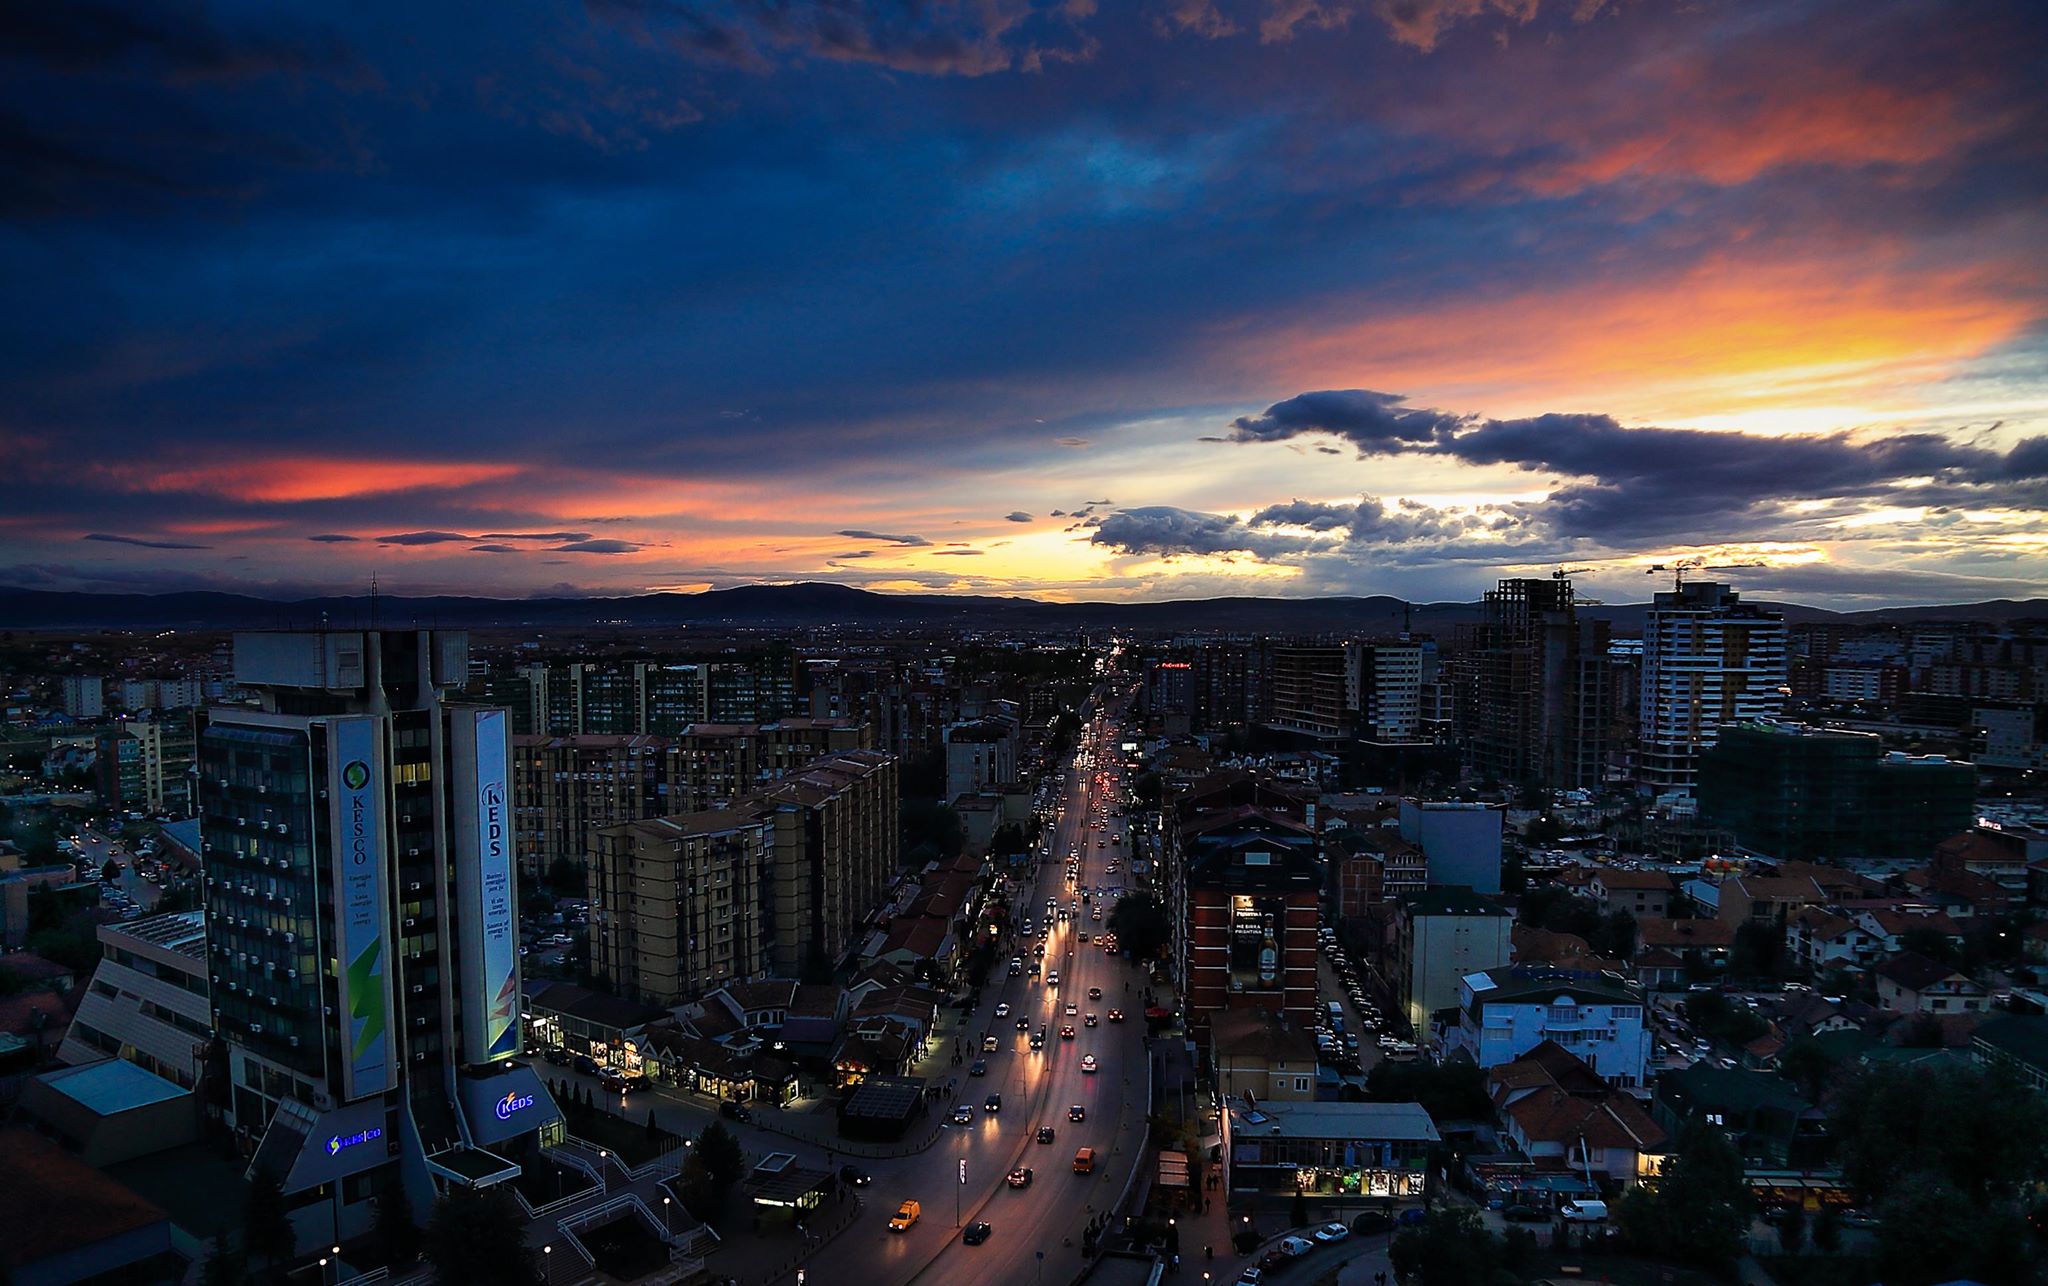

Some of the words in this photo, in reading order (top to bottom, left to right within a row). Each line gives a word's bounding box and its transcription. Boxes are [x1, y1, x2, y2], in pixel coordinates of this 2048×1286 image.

[352, 795, 367, 865] KESCO
[487, 782, 503, 857] KEDS
[498, 1092, 534, 1117] KEDS
